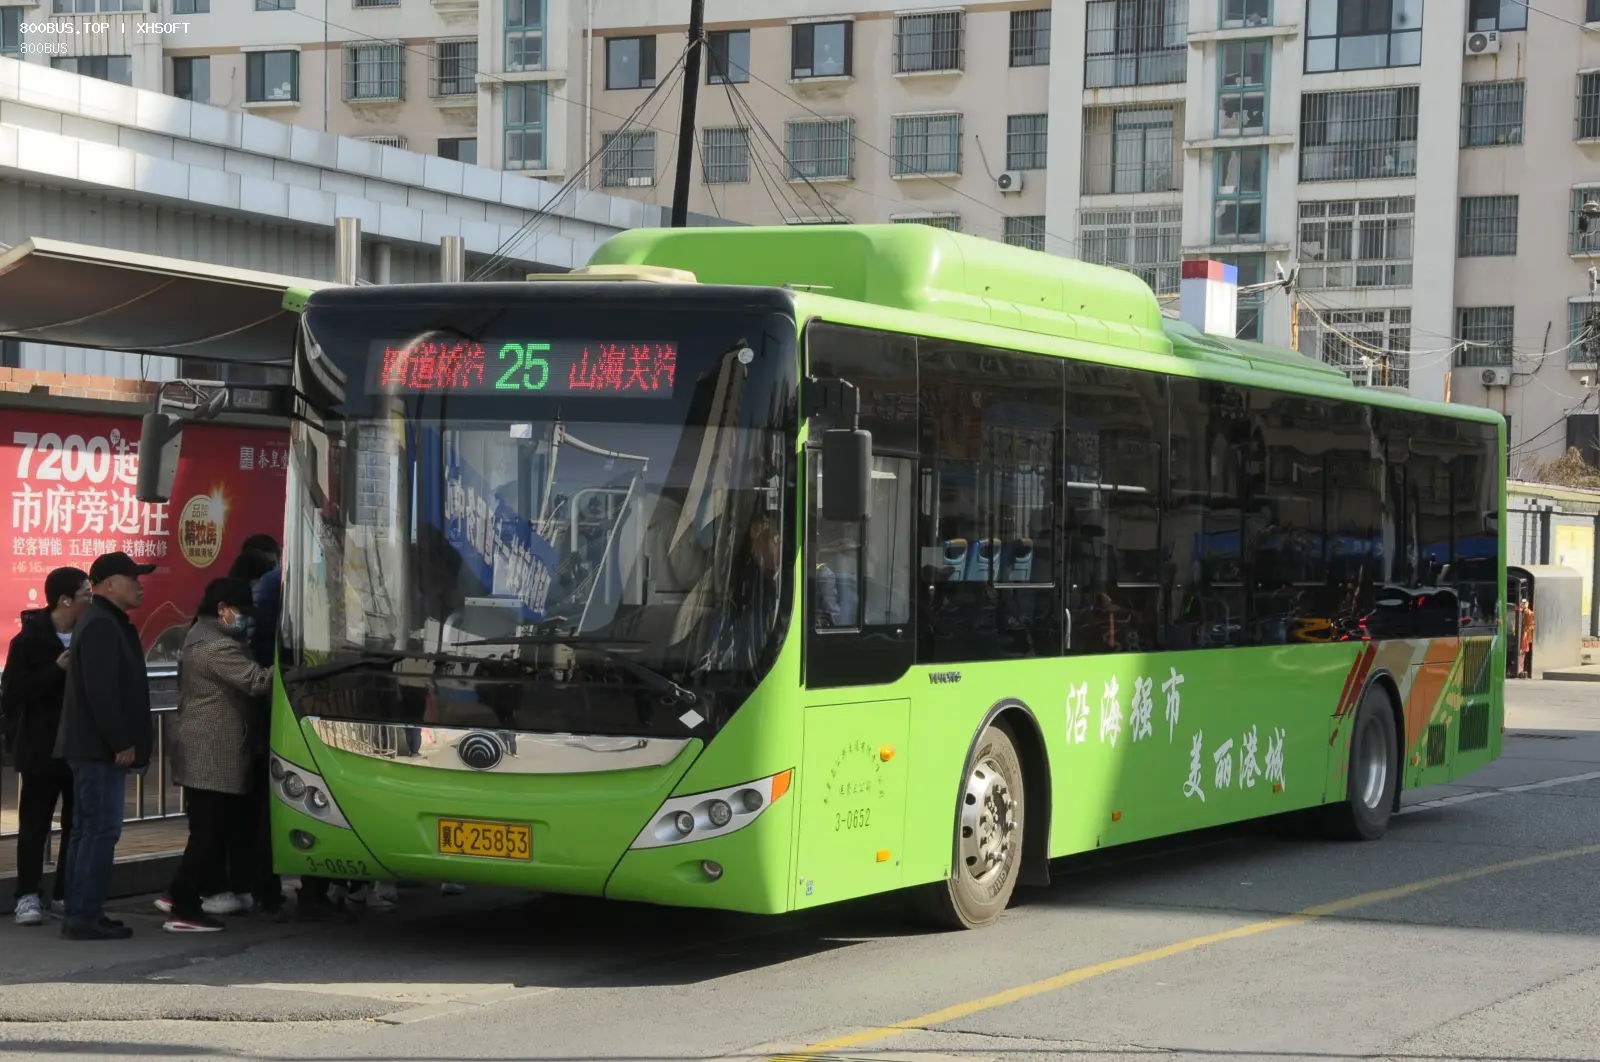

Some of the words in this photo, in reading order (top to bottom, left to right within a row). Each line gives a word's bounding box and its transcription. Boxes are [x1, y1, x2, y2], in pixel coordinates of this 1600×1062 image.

[495, 343, 551, 390] 25
[1066, 667, 1185, 748] 沿海强市
[1183, 724, 1286, 803] 美丽港城
[835, 807, 871, 832] 3-0652
[307, 857, 370, 876] 3-0652
